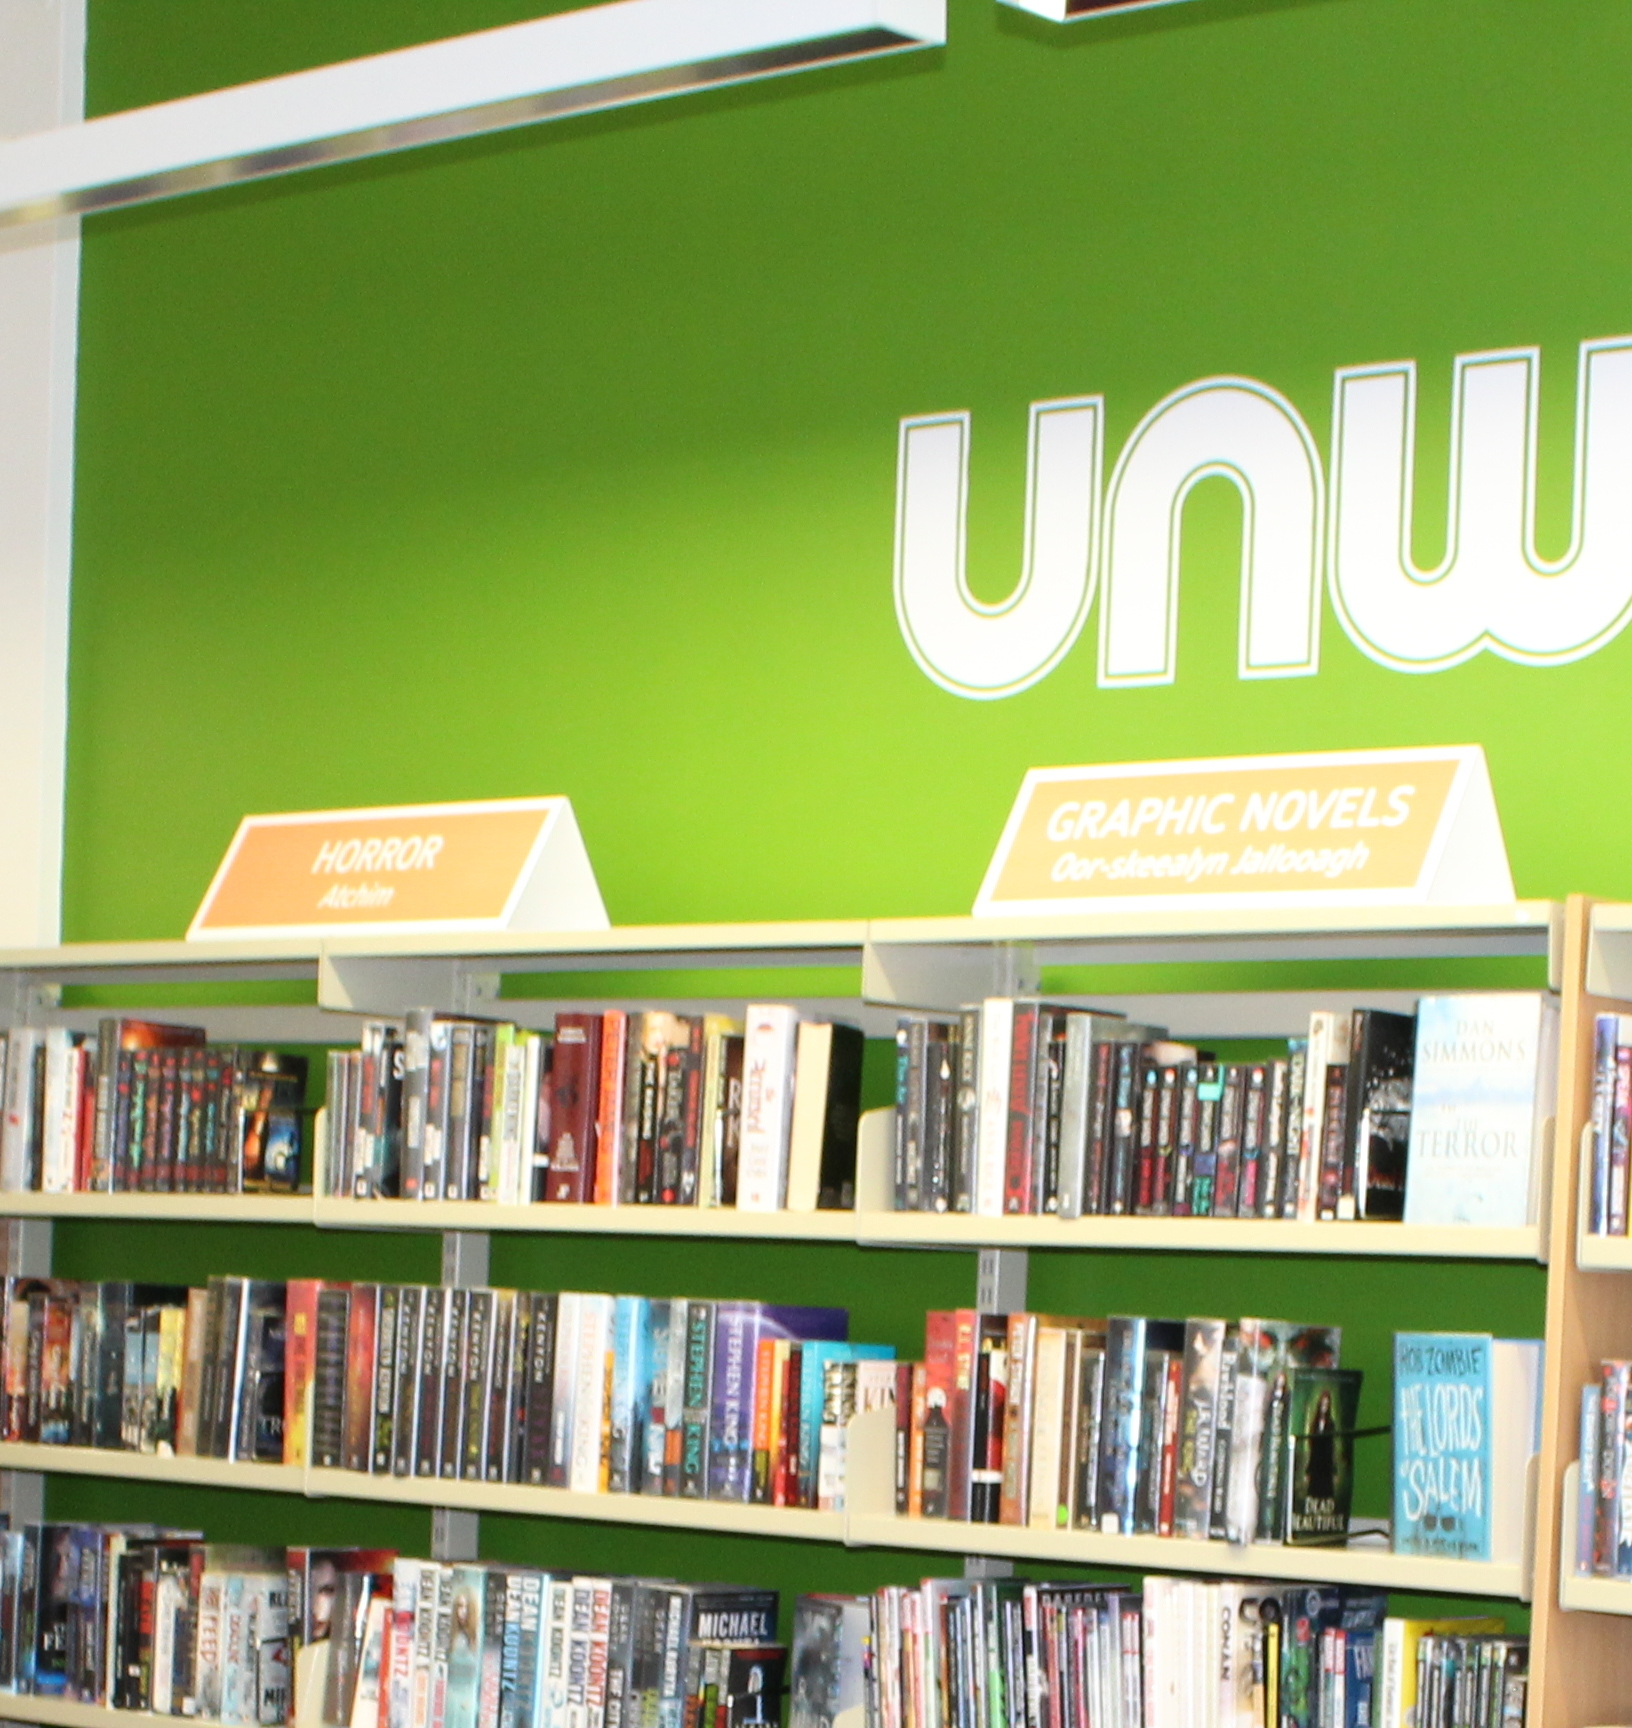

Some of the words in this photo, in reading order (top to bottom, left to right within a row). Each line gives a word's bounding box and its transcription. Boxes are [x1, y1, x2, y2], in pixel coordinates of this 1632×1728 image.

[1045, 791, 1233, 842] GRAPHIC
[1239, 784, 1415, 833] NOVELS
[312, 833, 443, 876] HORROR
[320, 882, 394, 912] Atchim
[1420, 1037, 1527, 1065] SIMMONS
[1417, 1129, 1519, 1161] TERROR
[690, 1320, 705, 1407] STEPHEN
[725, 1318, 743, 1397] STEPHEN
[1425, 1346, 1482, 1377] ZOMBIE
[724, 1400, 741, 1444] KING
[1425, 1383, 1485, 1454] LORDS
[684, 1425, 701, 1473] KING
[1304, 1496, 1335, 1516] DEAD
[1403, 1456, 1482, 1523] SALEM
[520, 1577, 541, 1632] DEAN
[571, 1590, 589, 1631] DEAN
[591, 1590, 607, 1633] DEAN
[698, 1610, 769, 1639] MICHAEL
[501, 1623, 517, 1690] KOONTZ
[567, 1641, 585, 1707] KOONTZ
[587, 1642, 605, 1708] KOONTZ
